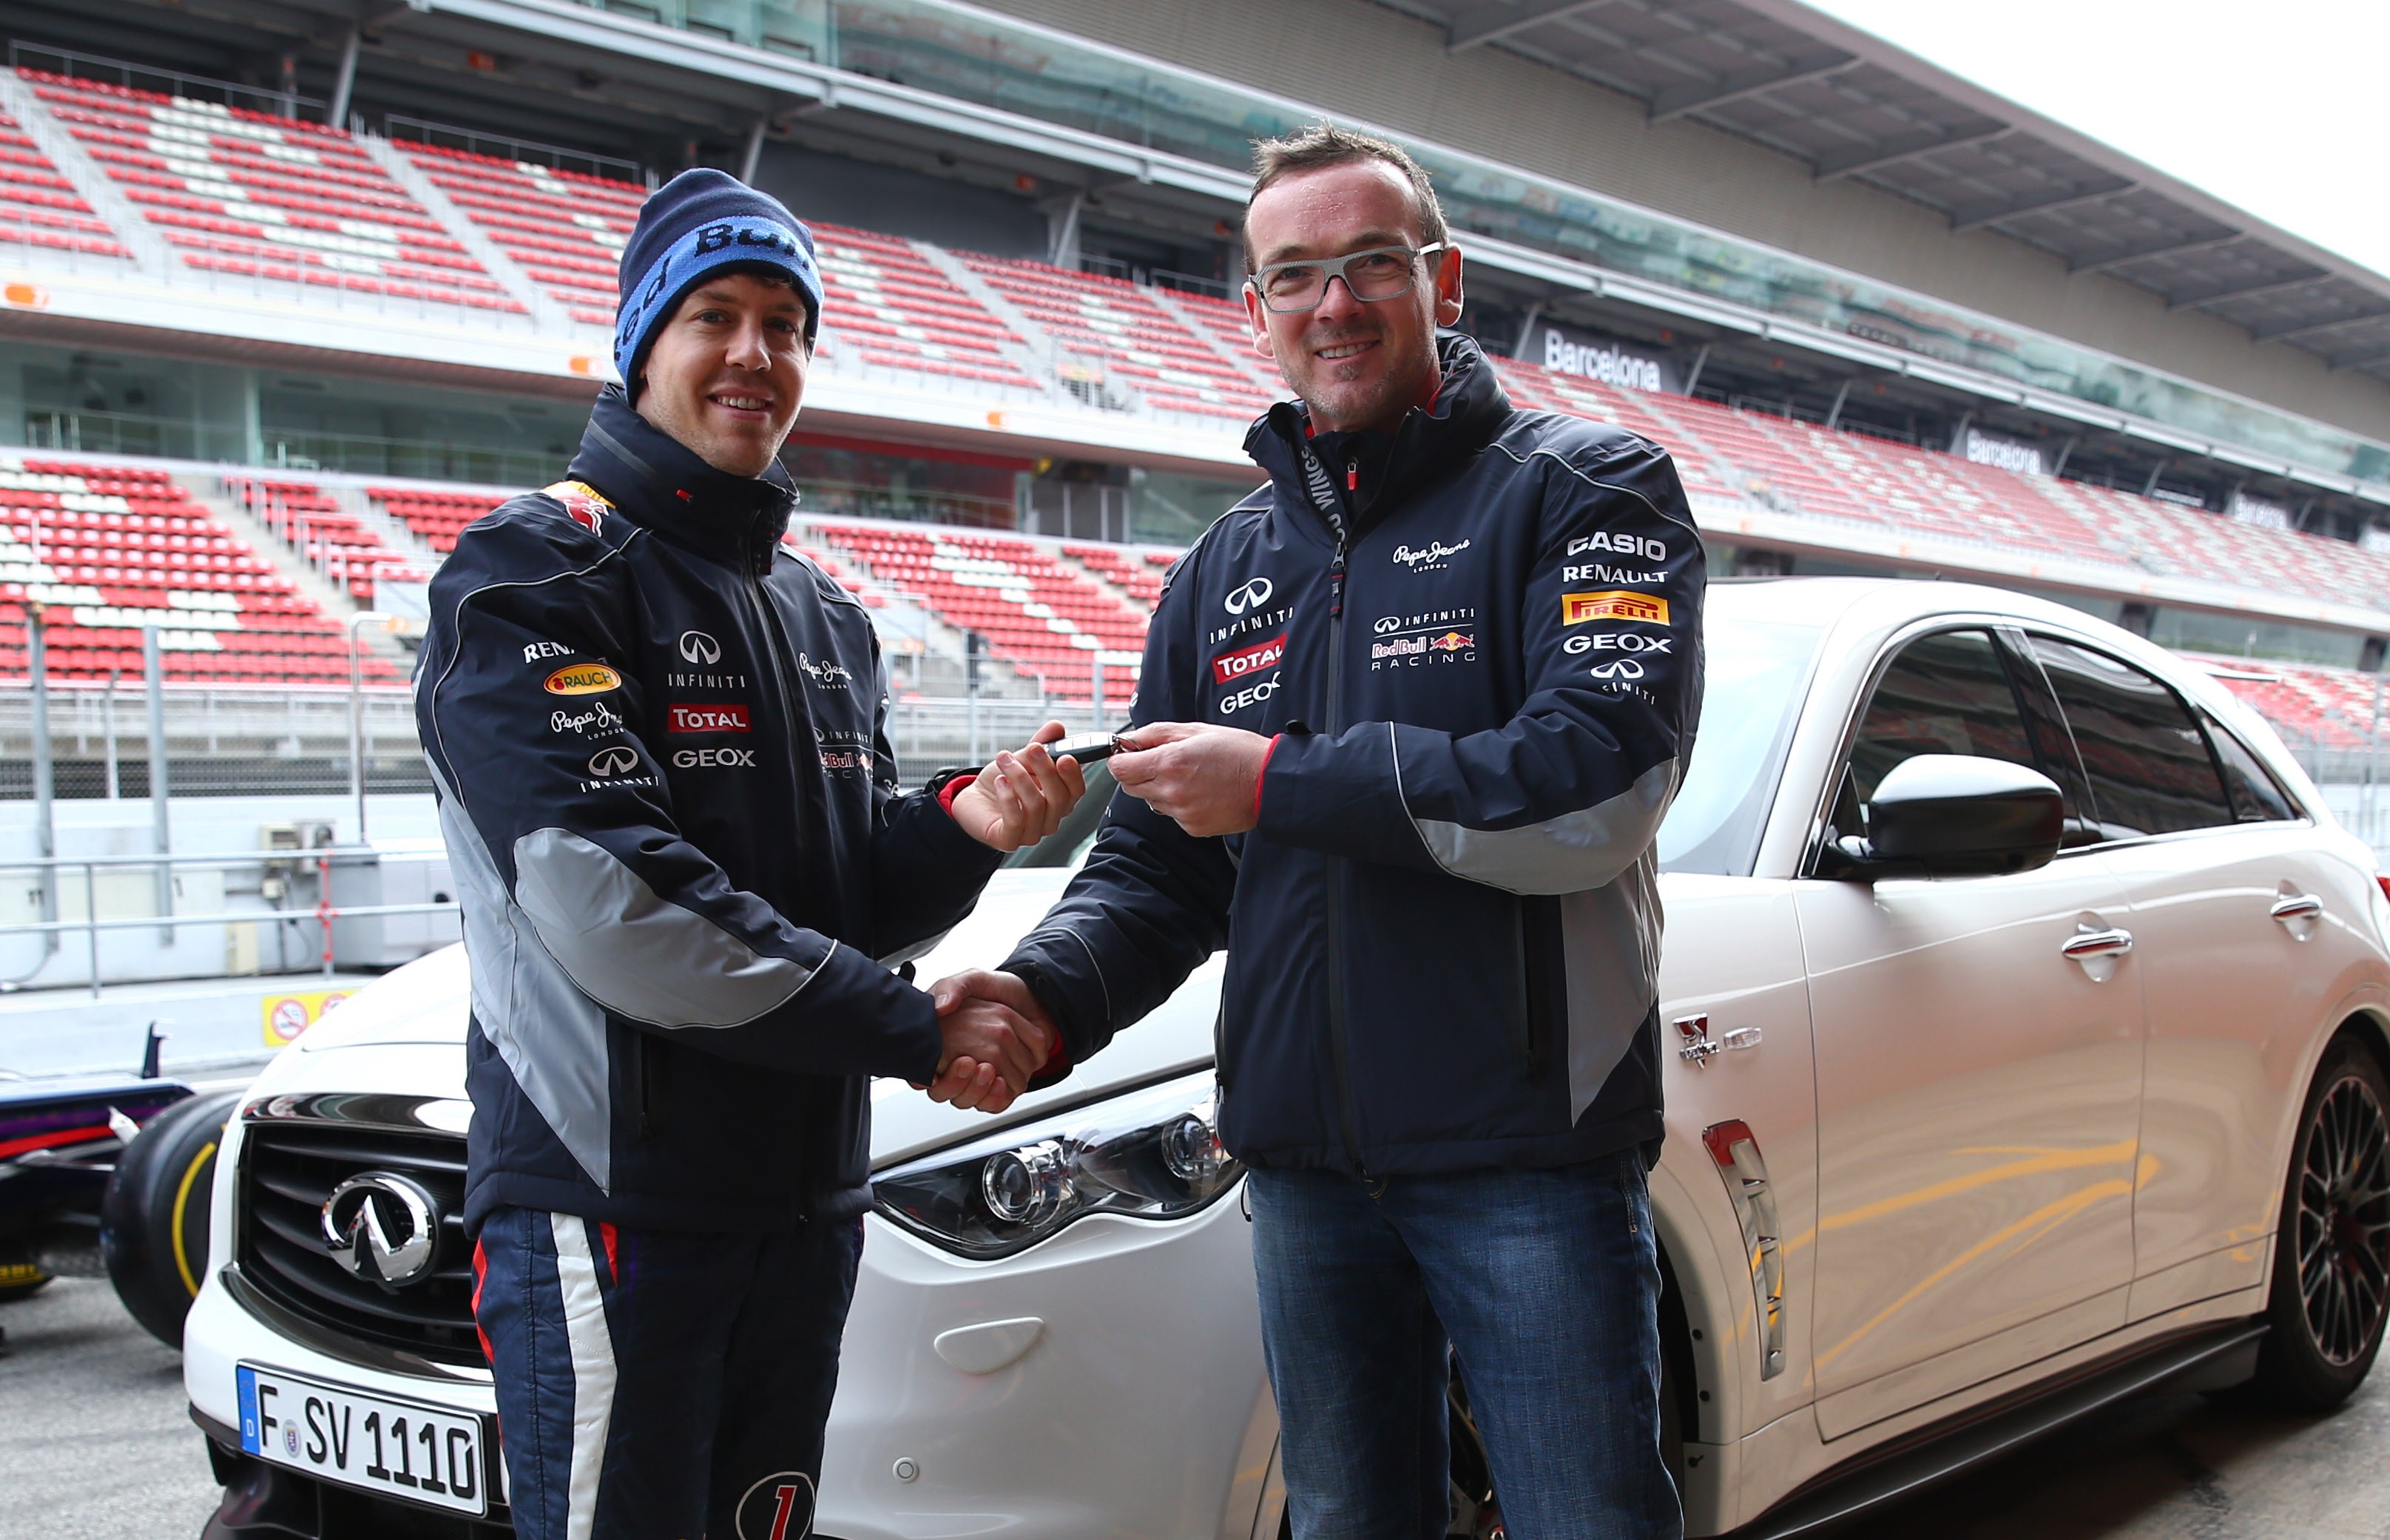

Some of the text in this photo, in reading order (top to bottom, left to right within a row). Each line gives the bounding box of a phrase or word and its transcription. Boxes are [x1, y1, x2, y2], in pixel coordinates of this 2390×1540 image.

[614, 223, 809, 362] ed Bu
[1545, 327, 1661, 392] Barcelona
[1301, 445, 1335, 511] WINGS
[1393, 539, 1471, 567] Pepe Jeans
[1567, 531, 1666, 561] CASIO
[1414, 564, 1448, 573] LONDON
[1563, 564, 1669, 584] RENAULT
[1405, 608, 1474, 626] INFINITI
[1571, 597, 1659, 620] PIRELLI
[1210, 607, 1294, 644] INFINITI
[1563, 634, 1672, 654] GEOX
[799, 652, 823, 680] Pepe
[1218, 645, 1283, 676] TOTAL
[1371, 652, 1476, 671] RACING
[564, 672, 613, 688] RAUCH
[668, 673, 746, 689] INFINITI
[1220, 671, 1281, 715] GEOX
[1602, 682, 1655, 705] FINITI
[551, 711, 596, 733] Pepe
[673, 709, 746, 728] TOTAL
[672, 748, 757, 768] GEOX
[246, 1384, 476, 1499] D F SV 1110
[770, 1485, 797, 1540] 1
